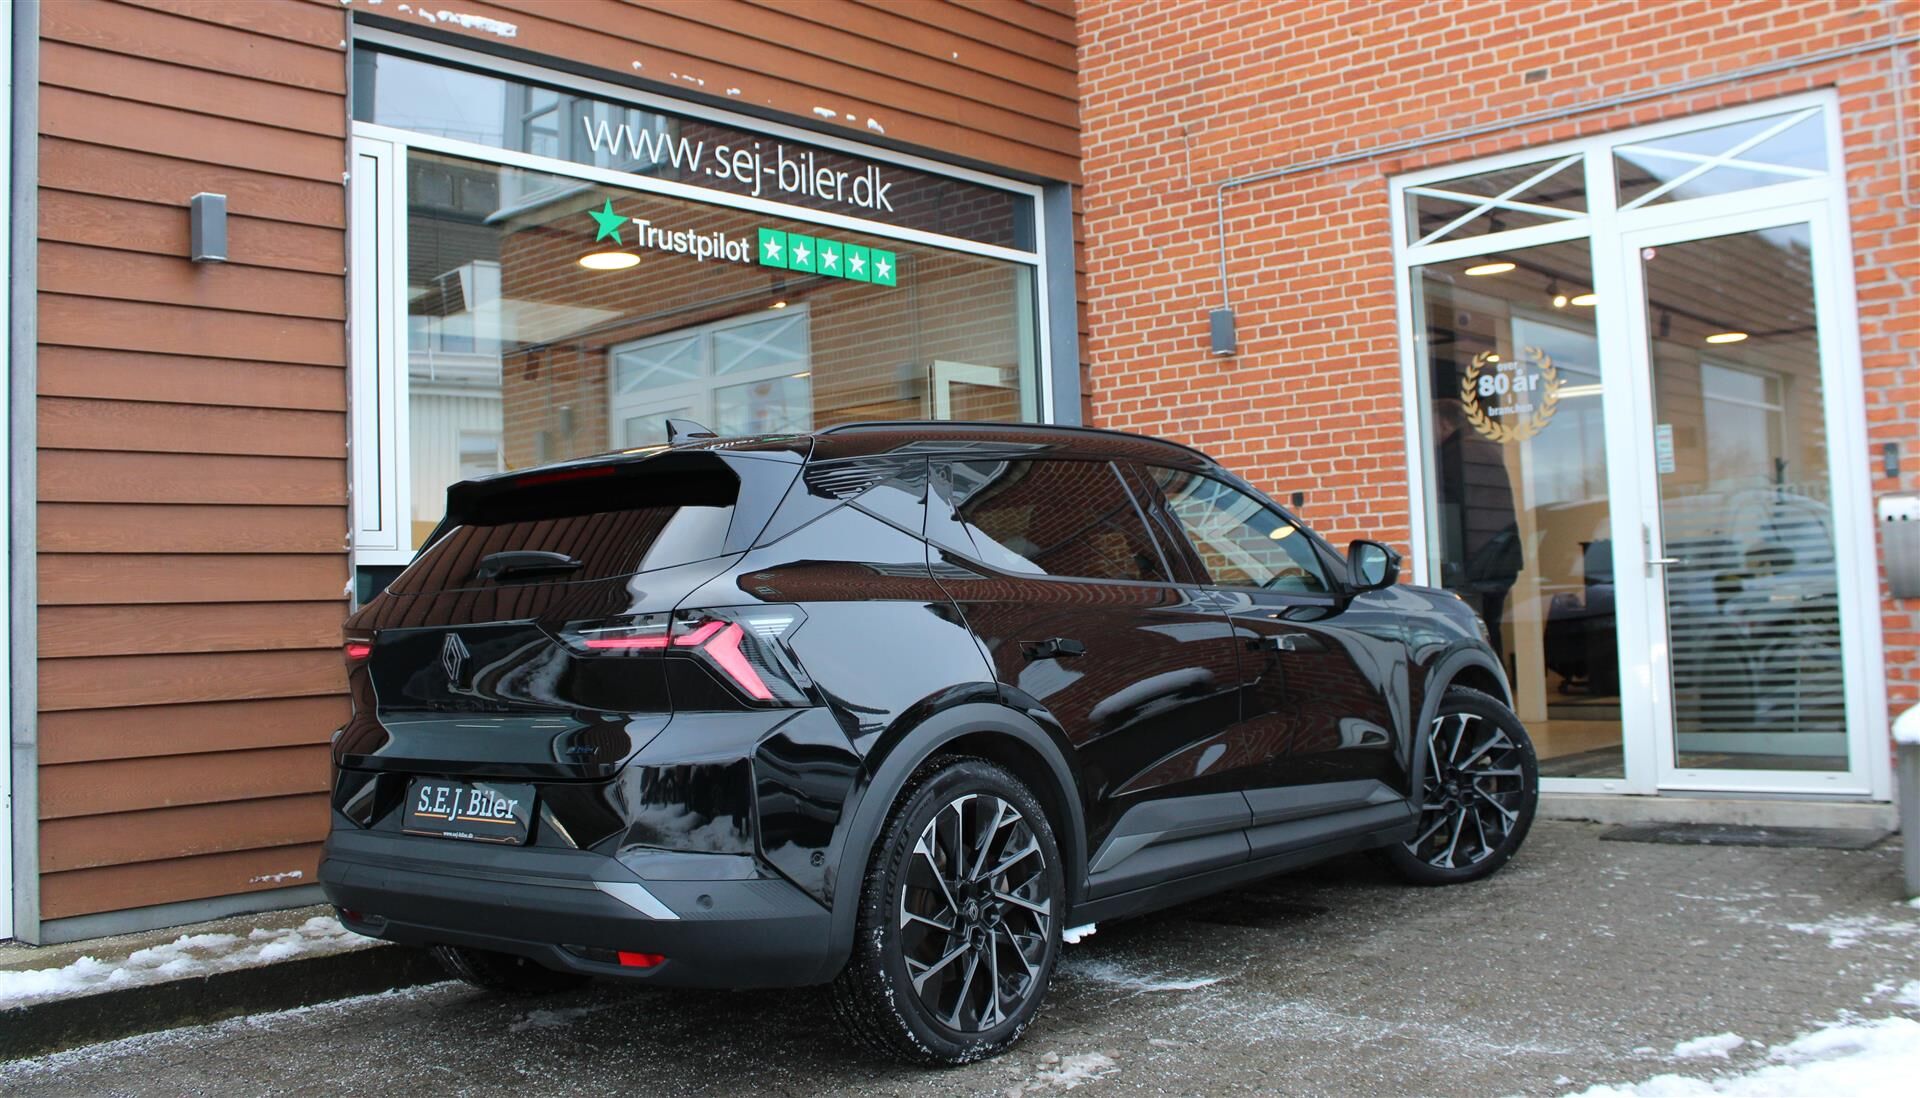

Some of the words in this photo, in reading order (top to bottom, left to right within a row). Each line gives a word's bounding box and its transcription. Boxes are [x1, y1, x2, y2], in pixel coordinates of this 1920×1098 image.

[583, 116, 894, 212] www.sej-biler.dk
[632, 218, 750, 263] Trustpilot
[1479, 374, 1510, 396] 80
[1513, 369, 1539, 393] år
[1497, 363, 1517, 372] over
[417, 786, 463, 821] S.E.J.
[466, 789, 518, 819] Biler
